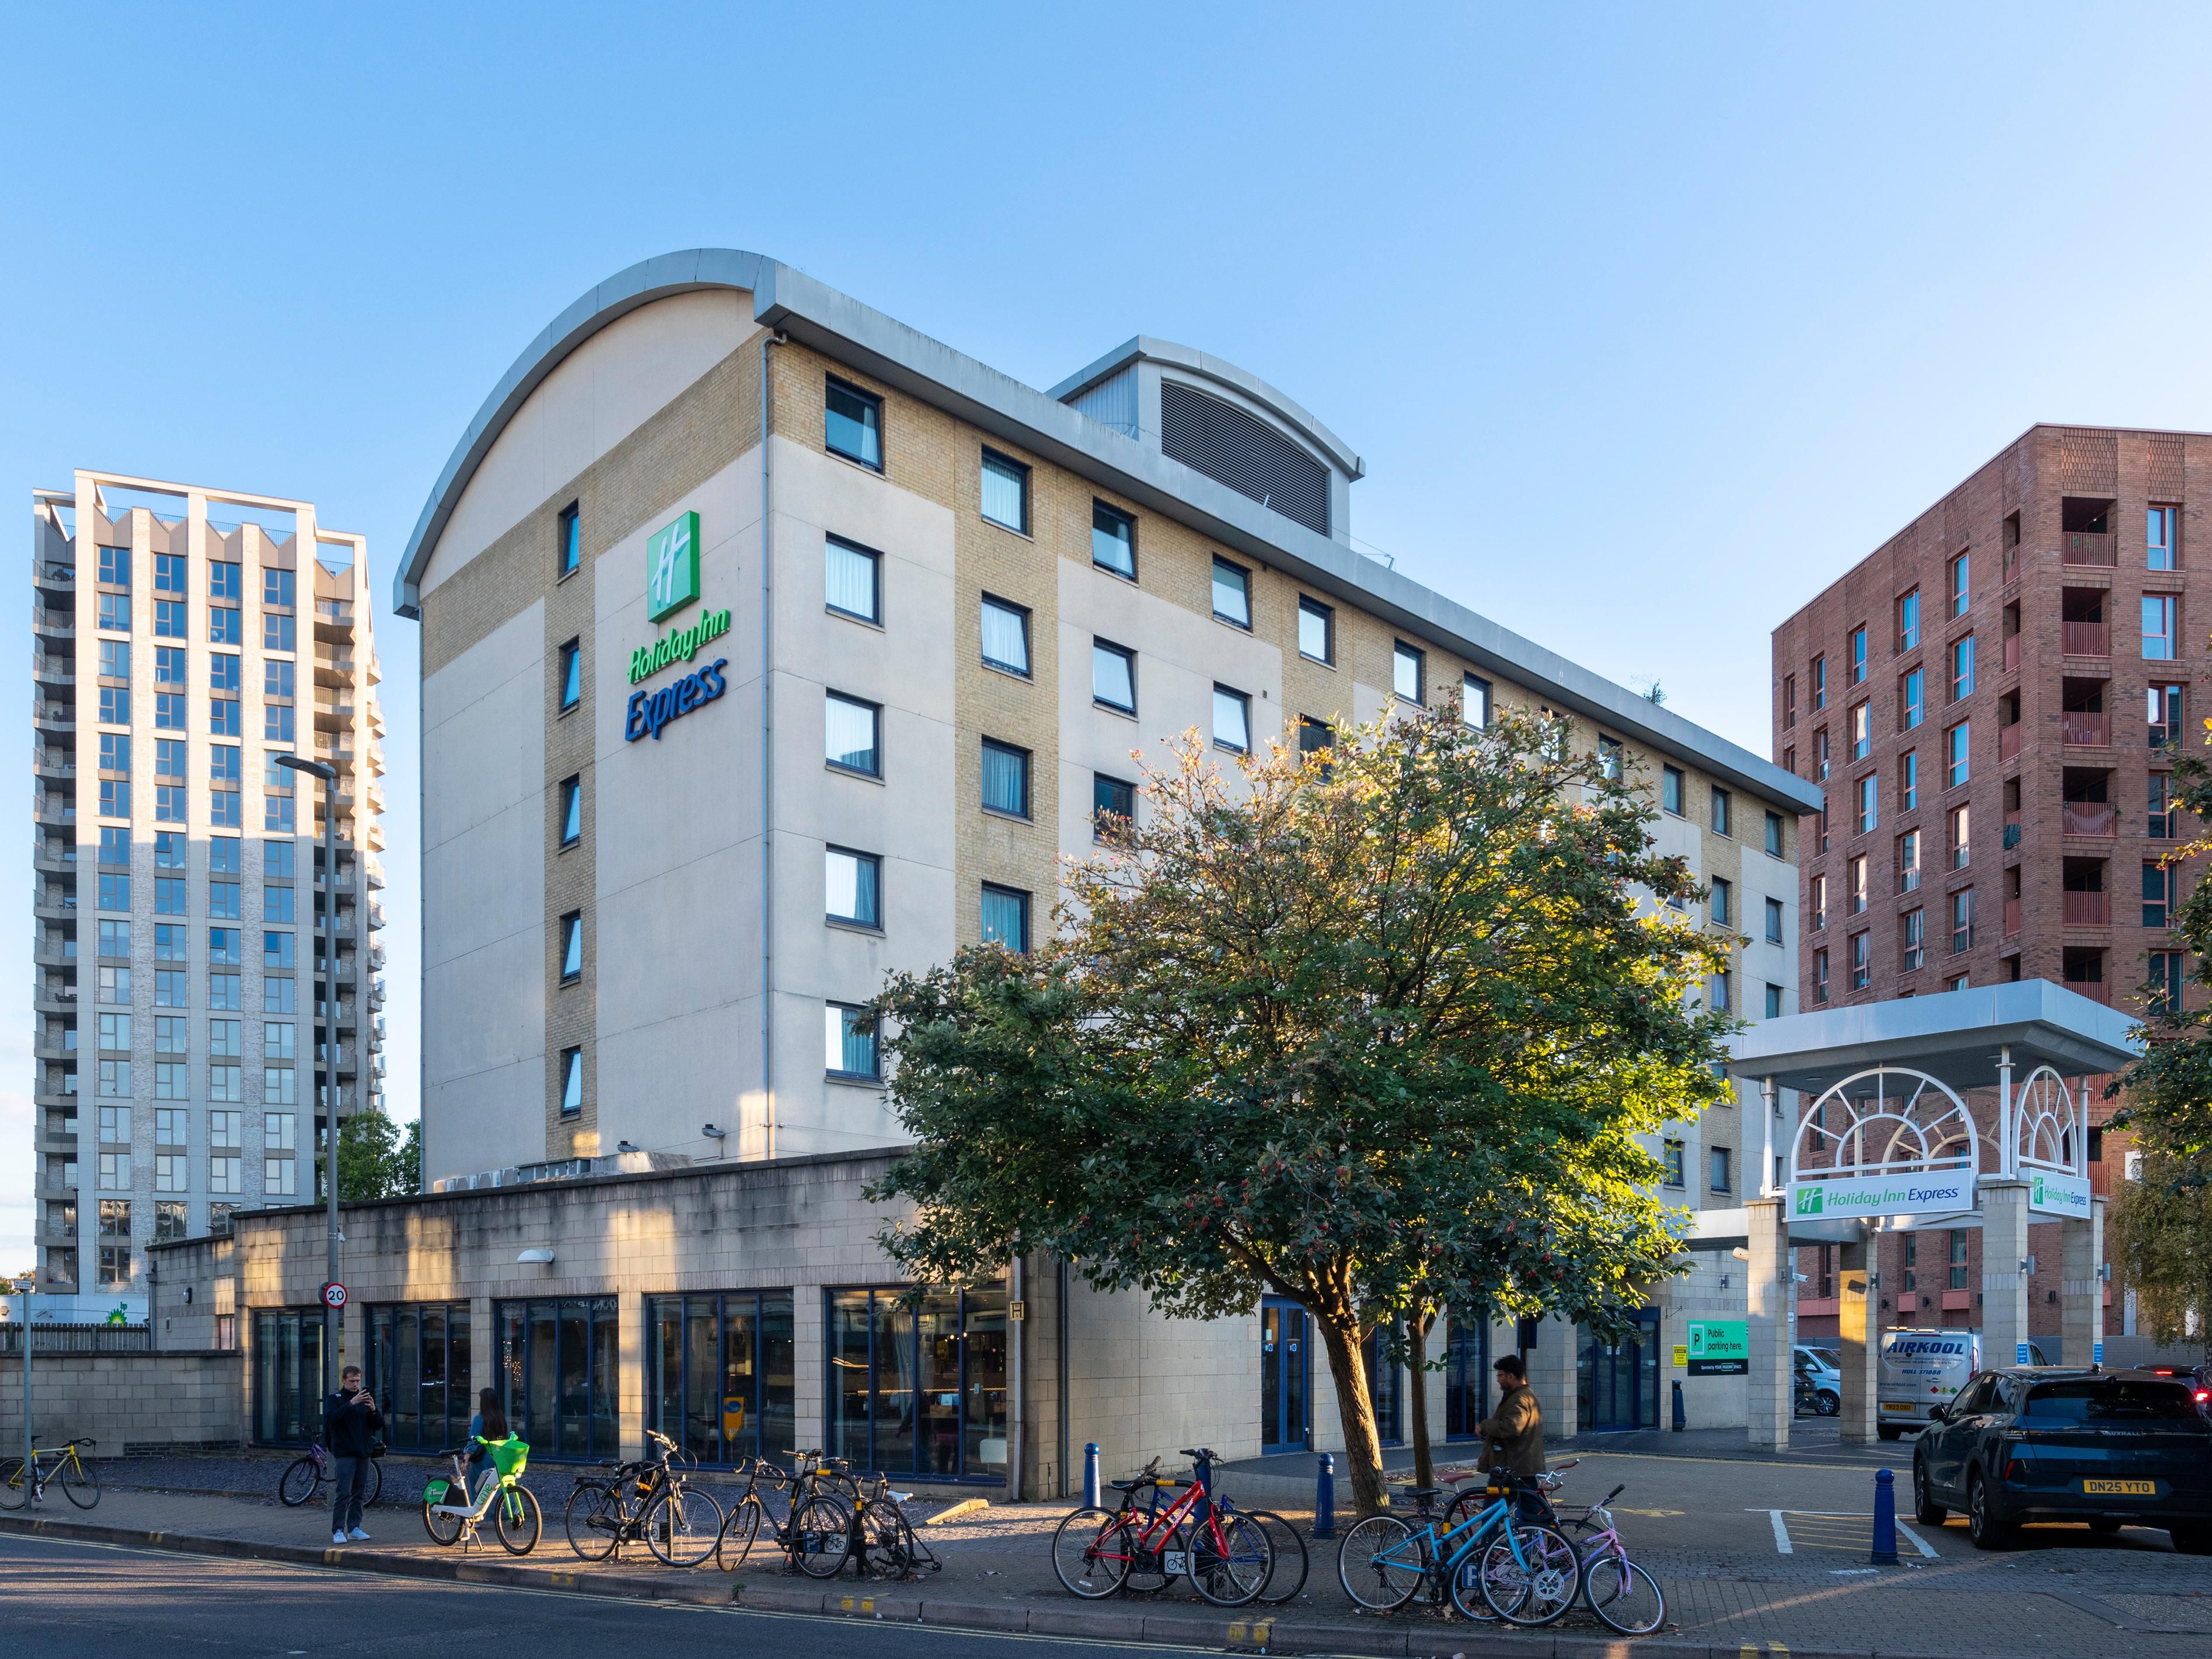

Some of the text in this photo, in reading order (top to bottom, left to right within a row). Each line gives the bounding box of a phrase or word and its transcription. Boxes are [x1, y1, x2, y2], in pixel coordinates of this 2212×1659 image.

[627, 609, 730, 686] Holiday Inn
[625, 658, 728, 742] Express
[1827, 1188, 1959, 1206] Holiday Inn Express
[2044, 1185, 2063, 1204] Holiday
[2071, 1192, 2087, 1207] Express
[328, 1290, 344, 1301] 20
[120, 1301, 127, 1311] bp
[1708, 1329, 1725, 1337] Public
[1694, 1333, 1700, 1346] P
[1708, 1341, 1743, 1352] parking here.
[1886, 1342, 1964, 1354] AIRKOOL
[2089, 1482, 2150, 1492] DN25 YTO
[1172, 1497, 1194, 1528] CHALLENGE
